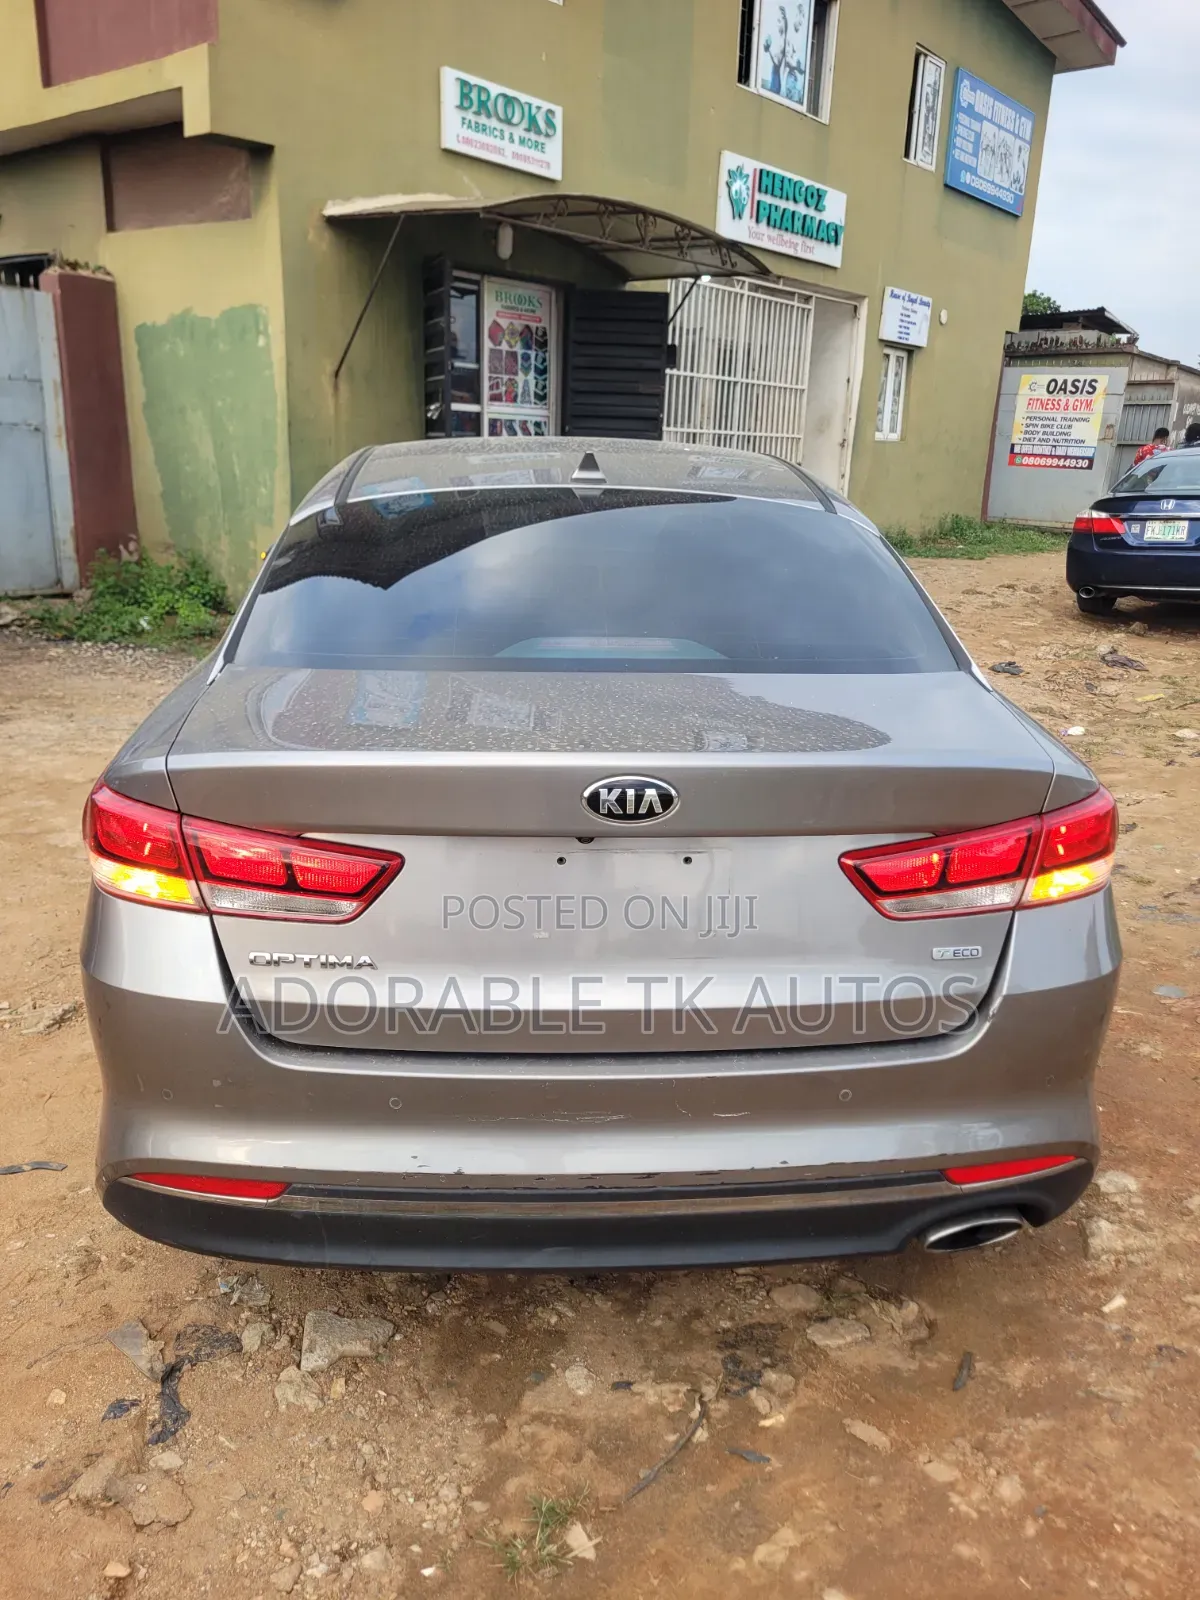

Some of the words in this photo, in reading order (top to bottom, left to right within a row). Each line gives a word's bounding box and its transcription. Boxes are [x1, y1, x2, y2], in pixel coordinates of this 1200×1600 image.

[455, 77, 557, 138] BROOKS
[461, 116, 505, 141] FABRICS
[508, 132, 515, 144] &
[519, 135, 546, 154] MORE
[758, 168, 828, 212] HENGOZ
[756, 199, 844, 247] PHARMACY
[747, 225, 765, 242] Your
[767, 233, 799, 255] wellbeing
[801, 240, 815, 255] first
[495, 290, 543, 308] BROOKS
[1046, 378, 1098, 395] OASIS
[1026, 397, 1062, 412] FITNESS
[1063, 398, 1070, 411] &
[1022, 456, 1089, 468] 08069944930
[599, 788, 663, 814] KIA
[247, 951, 378, 970] OPTIMA
[953, 948, 980, 958] ECO
